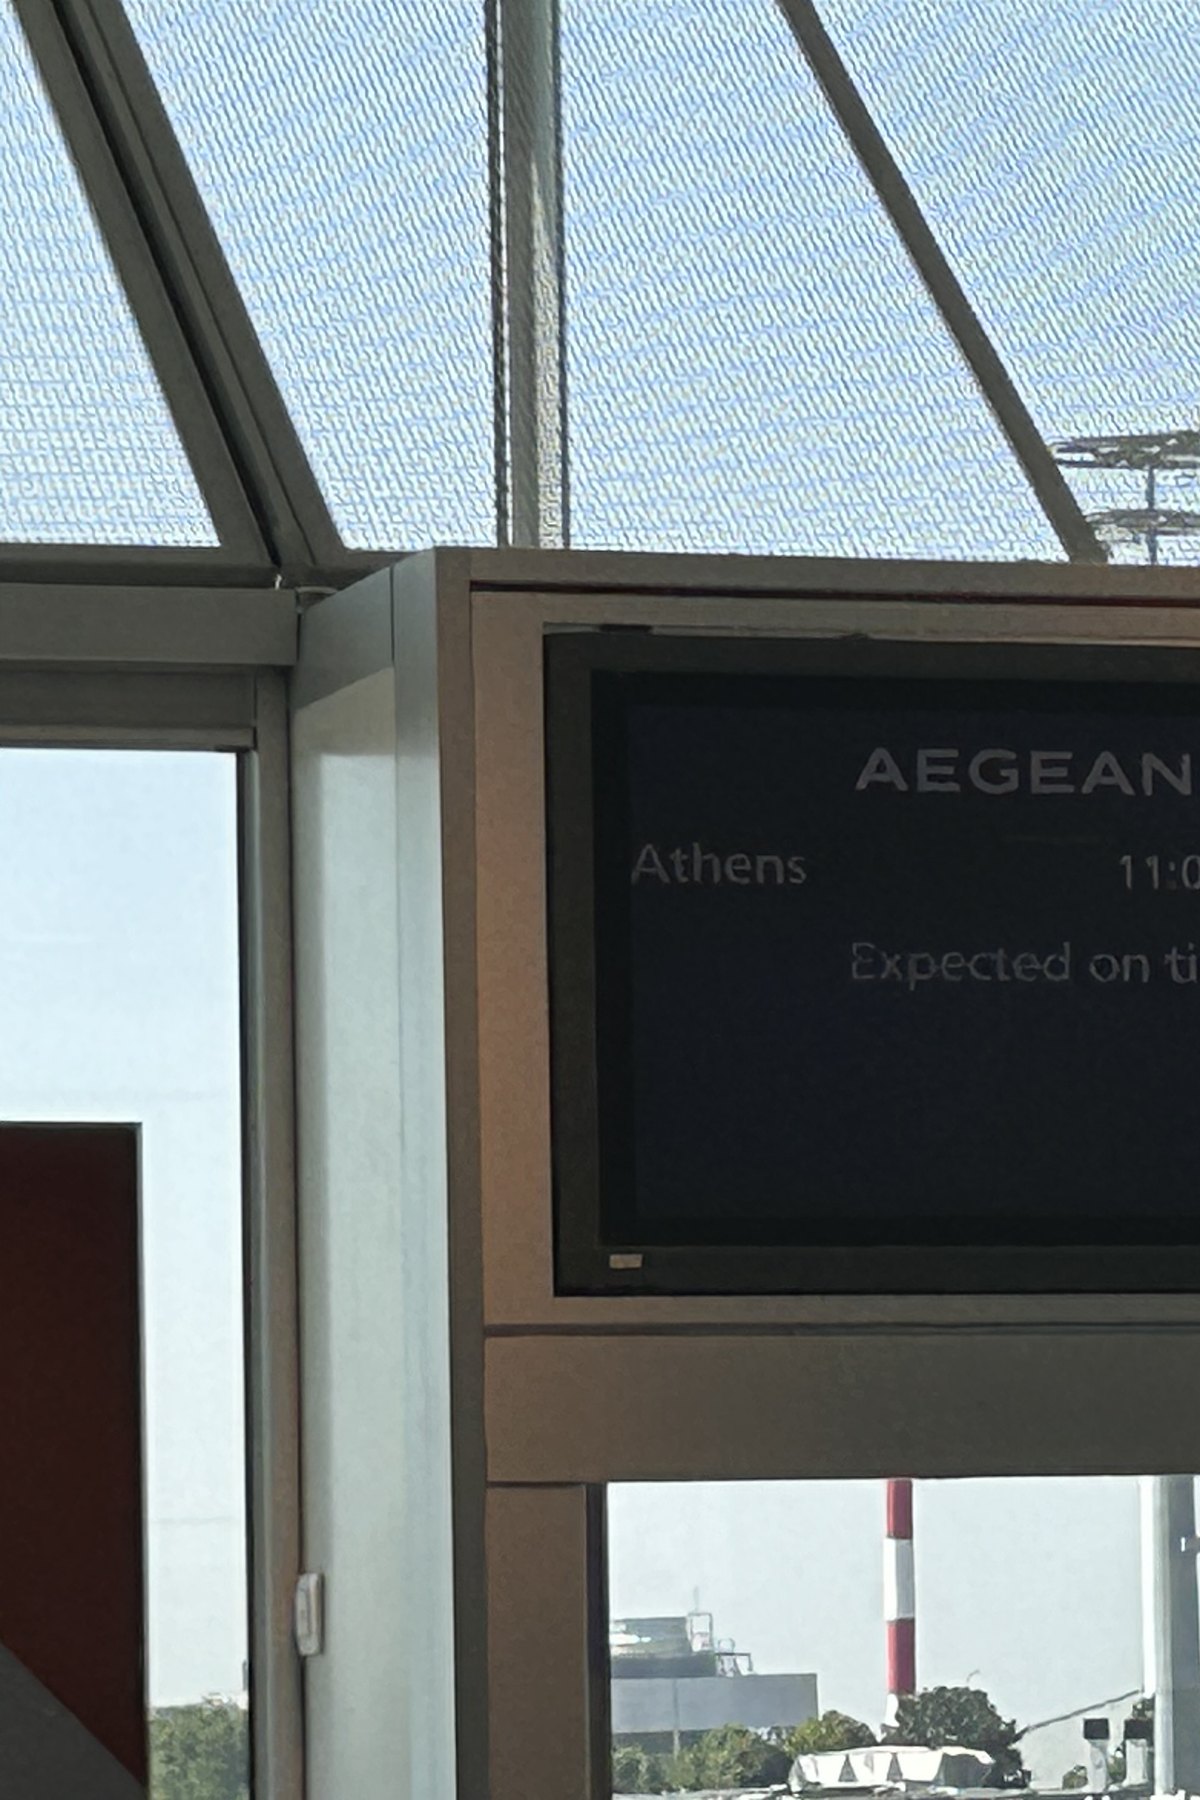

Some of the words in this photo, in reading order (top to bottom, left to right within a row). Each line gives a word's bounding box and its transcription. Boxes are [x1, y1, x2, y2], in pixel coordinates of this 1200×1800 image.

[854, 747, 1193, 797] AEGEAN
[631, 842, 808, 886] Athens
[850, 941, 1072, 992] Expected
[1089, 953, 1151, 984] on
